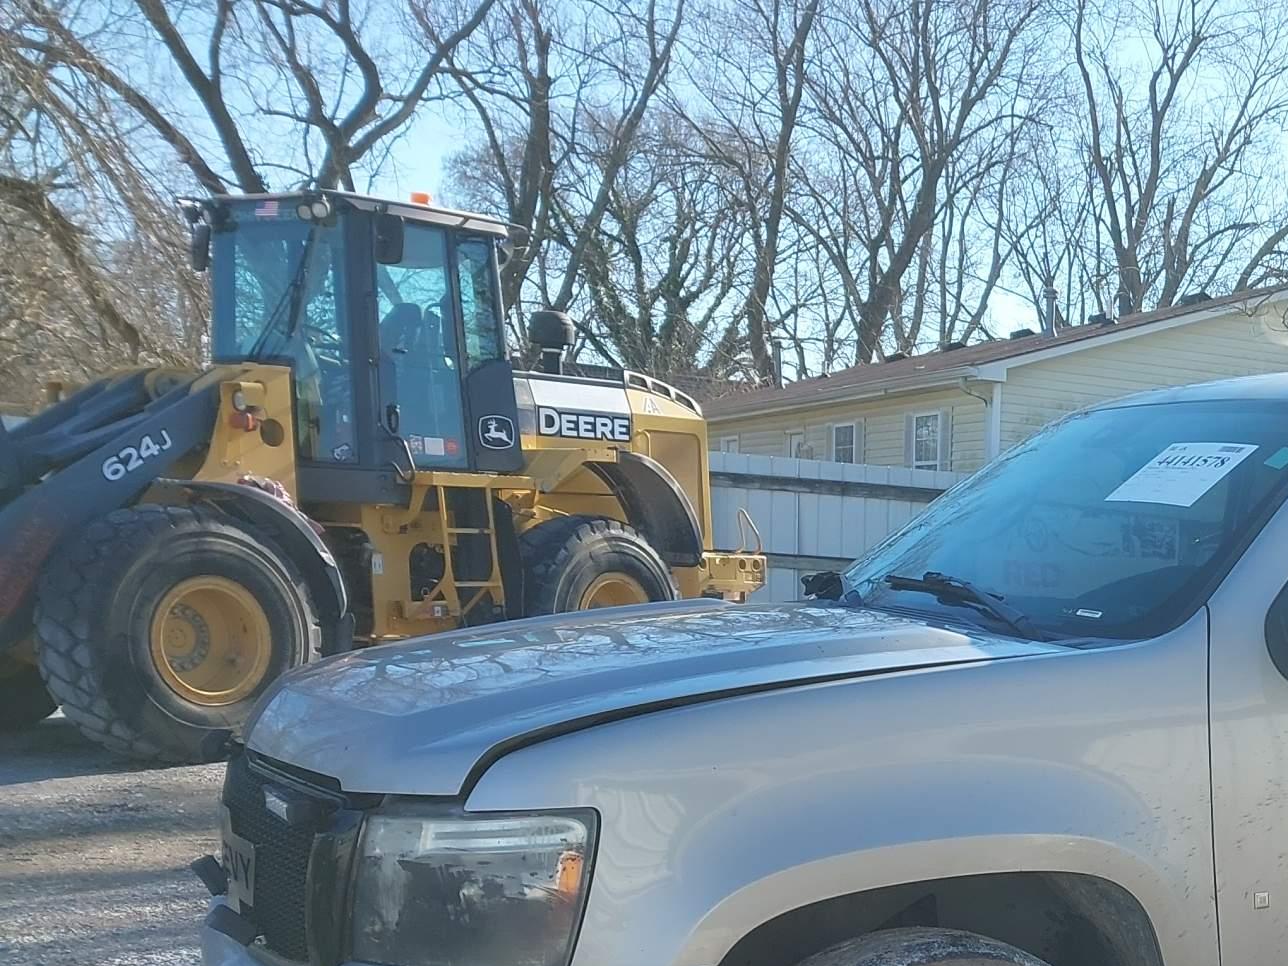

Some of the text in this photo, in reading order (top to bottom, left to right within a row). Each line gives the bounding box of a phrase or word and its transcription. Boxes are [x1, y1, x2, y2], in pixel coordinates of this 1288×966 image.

[538, 406, 631, 442] DEERE
[102, 430, 172, 481] 624J
[1157, 455, 1231, 469] 44141578
